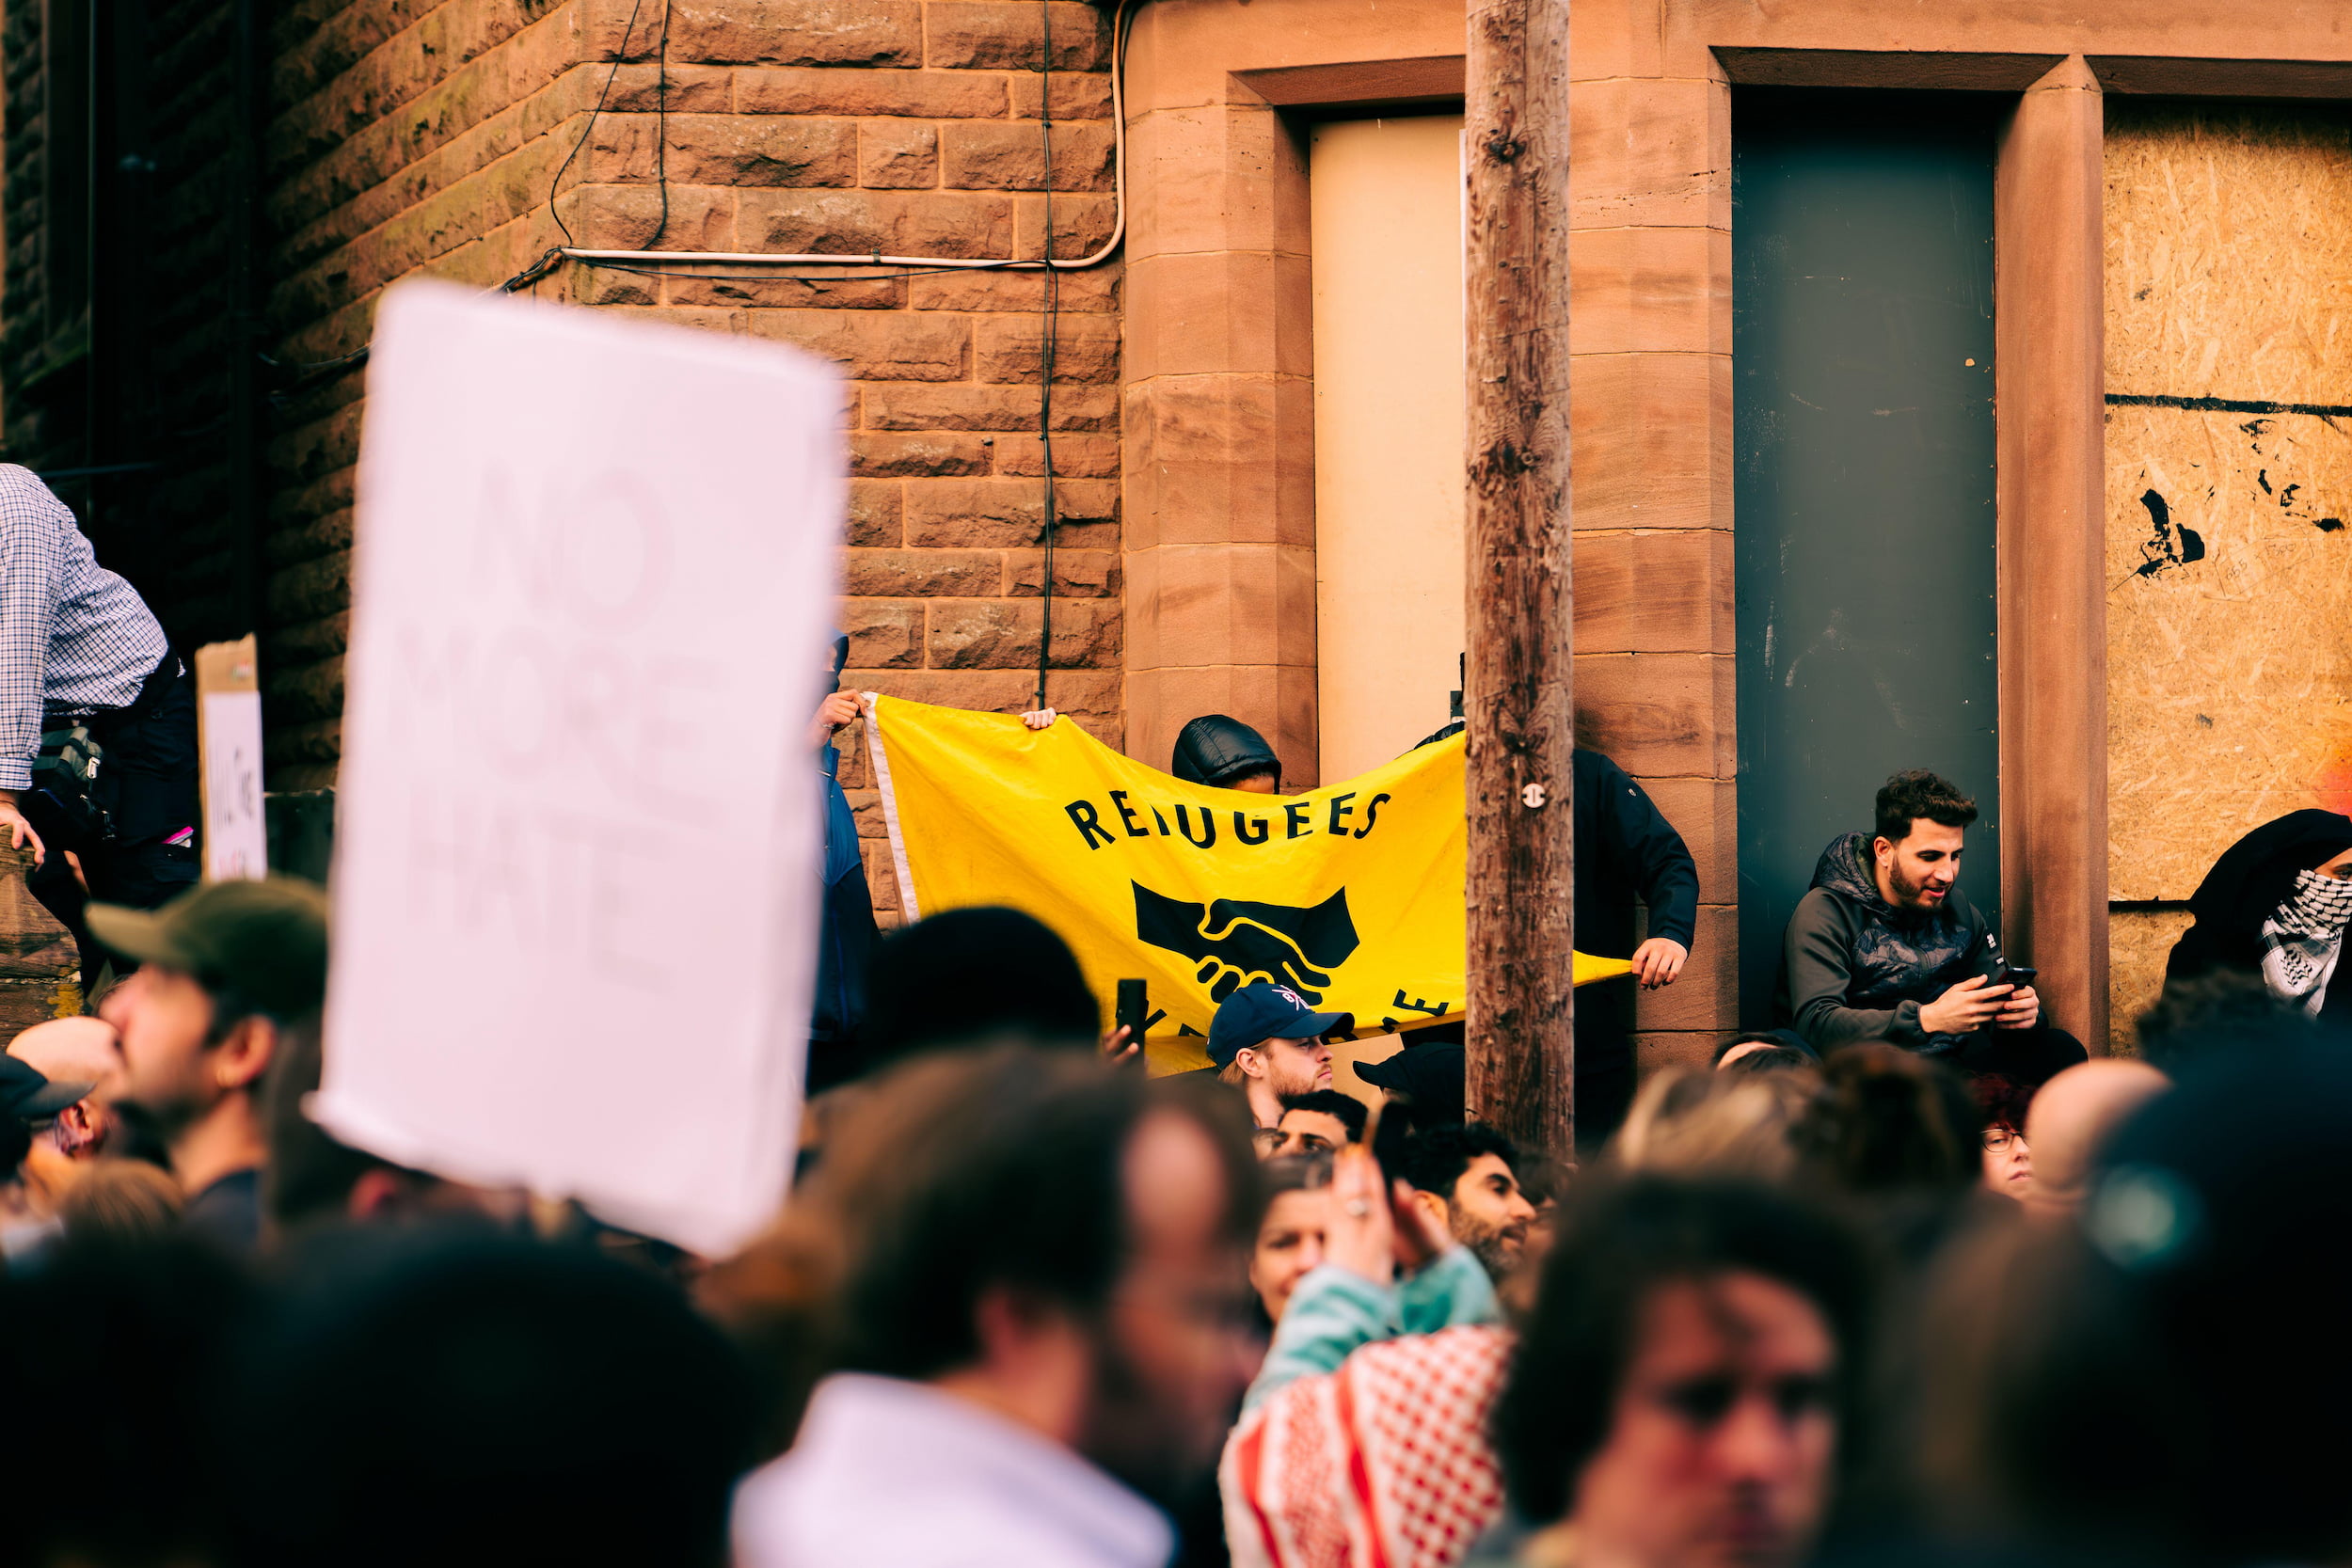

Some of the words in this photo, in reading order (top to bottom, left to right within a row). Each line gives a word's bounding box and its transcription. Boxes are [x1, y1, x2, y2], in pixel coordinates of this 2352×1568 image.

[466, 457, 676, 636] NO
[388, 621, 732, 830] MORE
[407, 777, 677, 997] HATE
